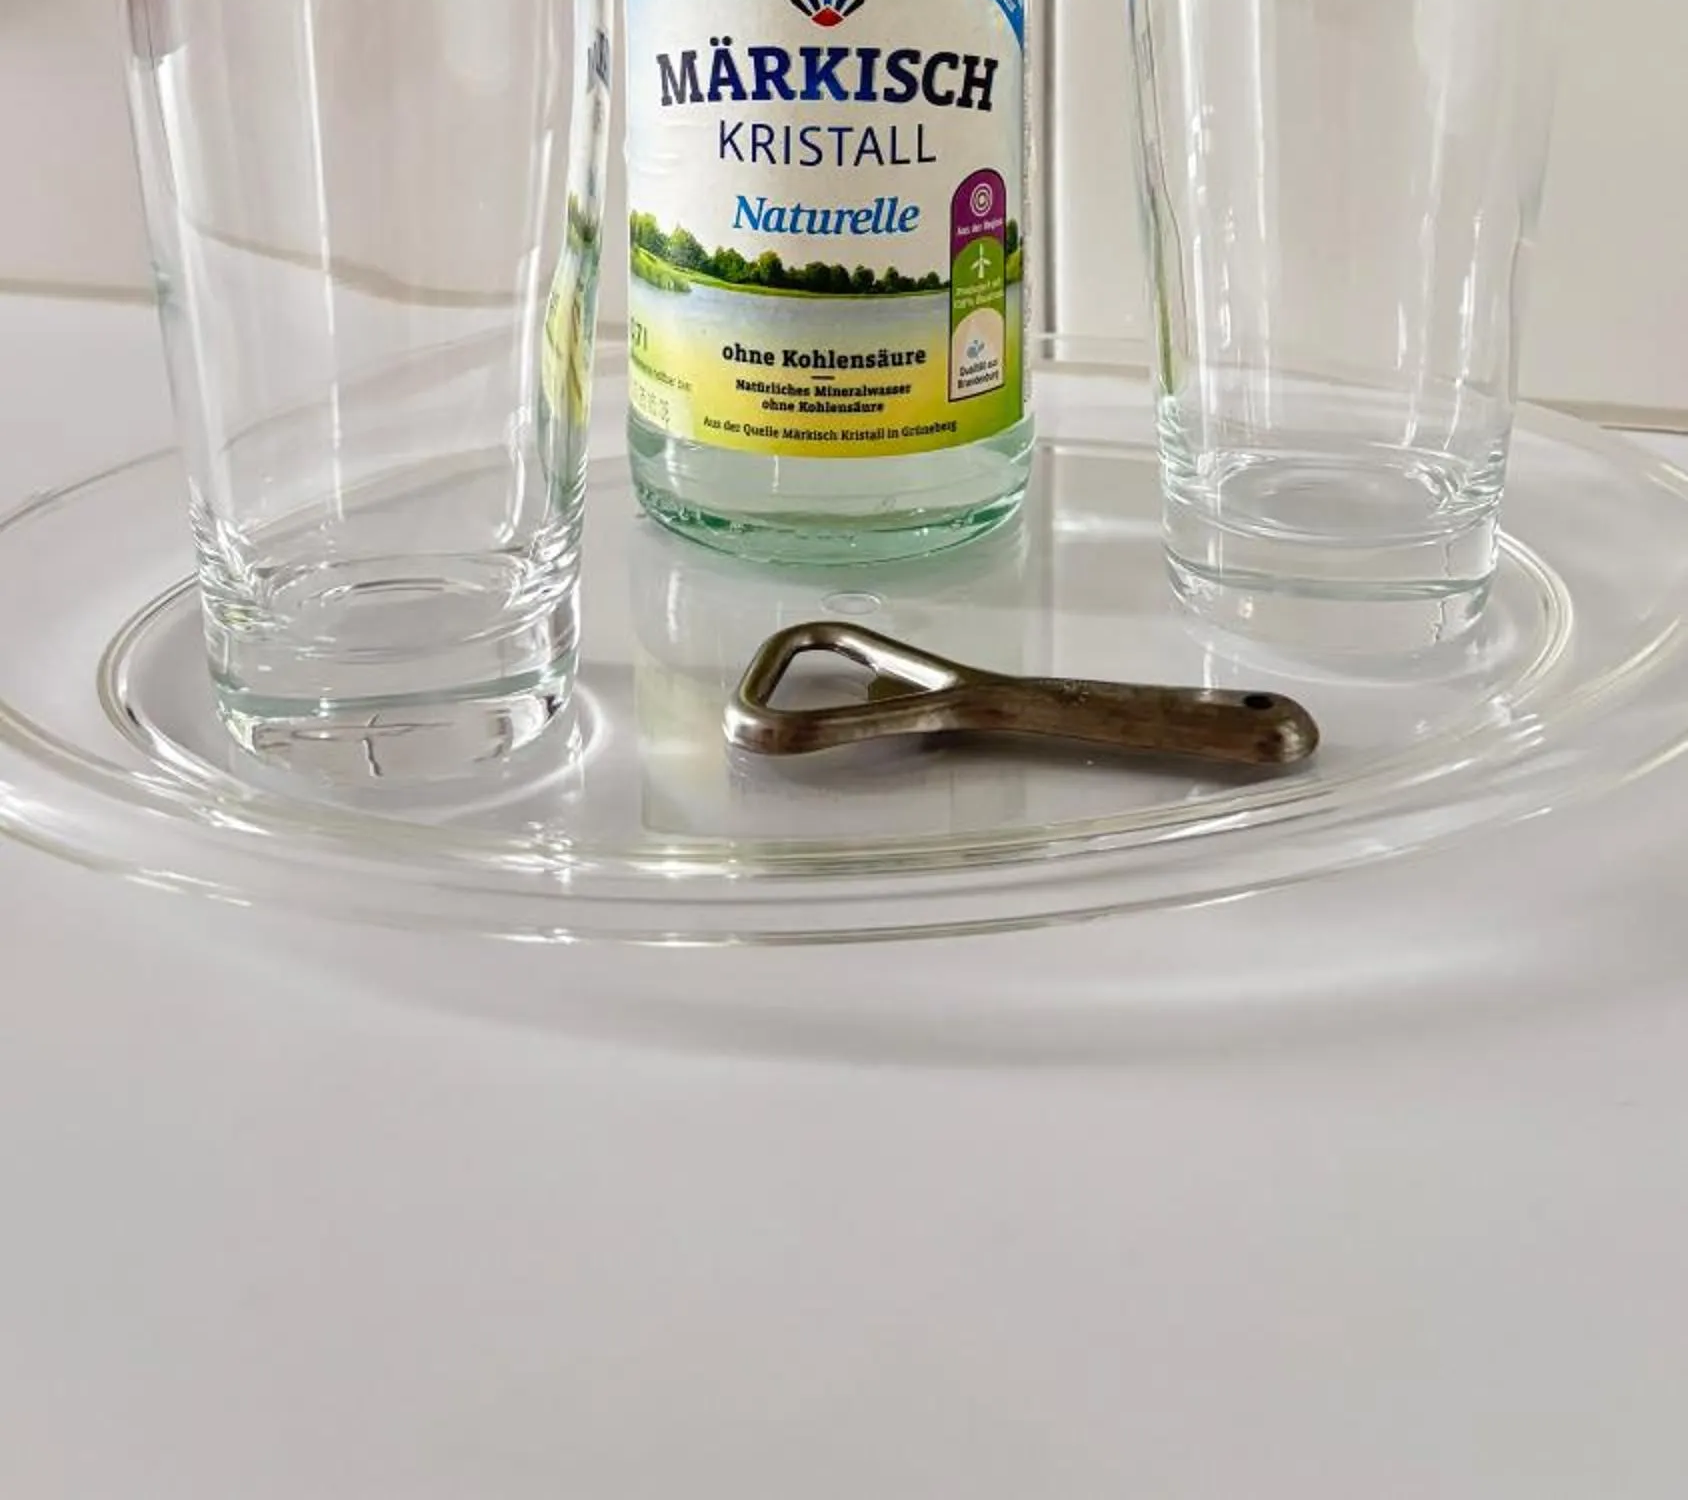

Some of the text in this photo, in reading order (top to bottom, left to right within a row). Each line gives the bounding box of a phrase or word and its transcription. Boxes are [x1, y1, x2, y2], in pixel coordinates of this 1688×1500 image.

[655, 35, 999, 111] MÄRKISCH
[719, 120, 937, 167] KRISTALL
[733, 194, 921, 236] Naturelle
[722, 344, 927, 369] ohne Kohlensäure
[735, 379, 911, 398] Natürliches Mineralwasser
[762, 398, 885, 413] ohne Kohlensäure
[703, 416, 722, 429] Aus
[743, 424, 779, 439] Quelle
[783, 427, 840, 441] Märkisch
[841, 429, 885, 441] Kristall
[887, 429, 899, 439] in
